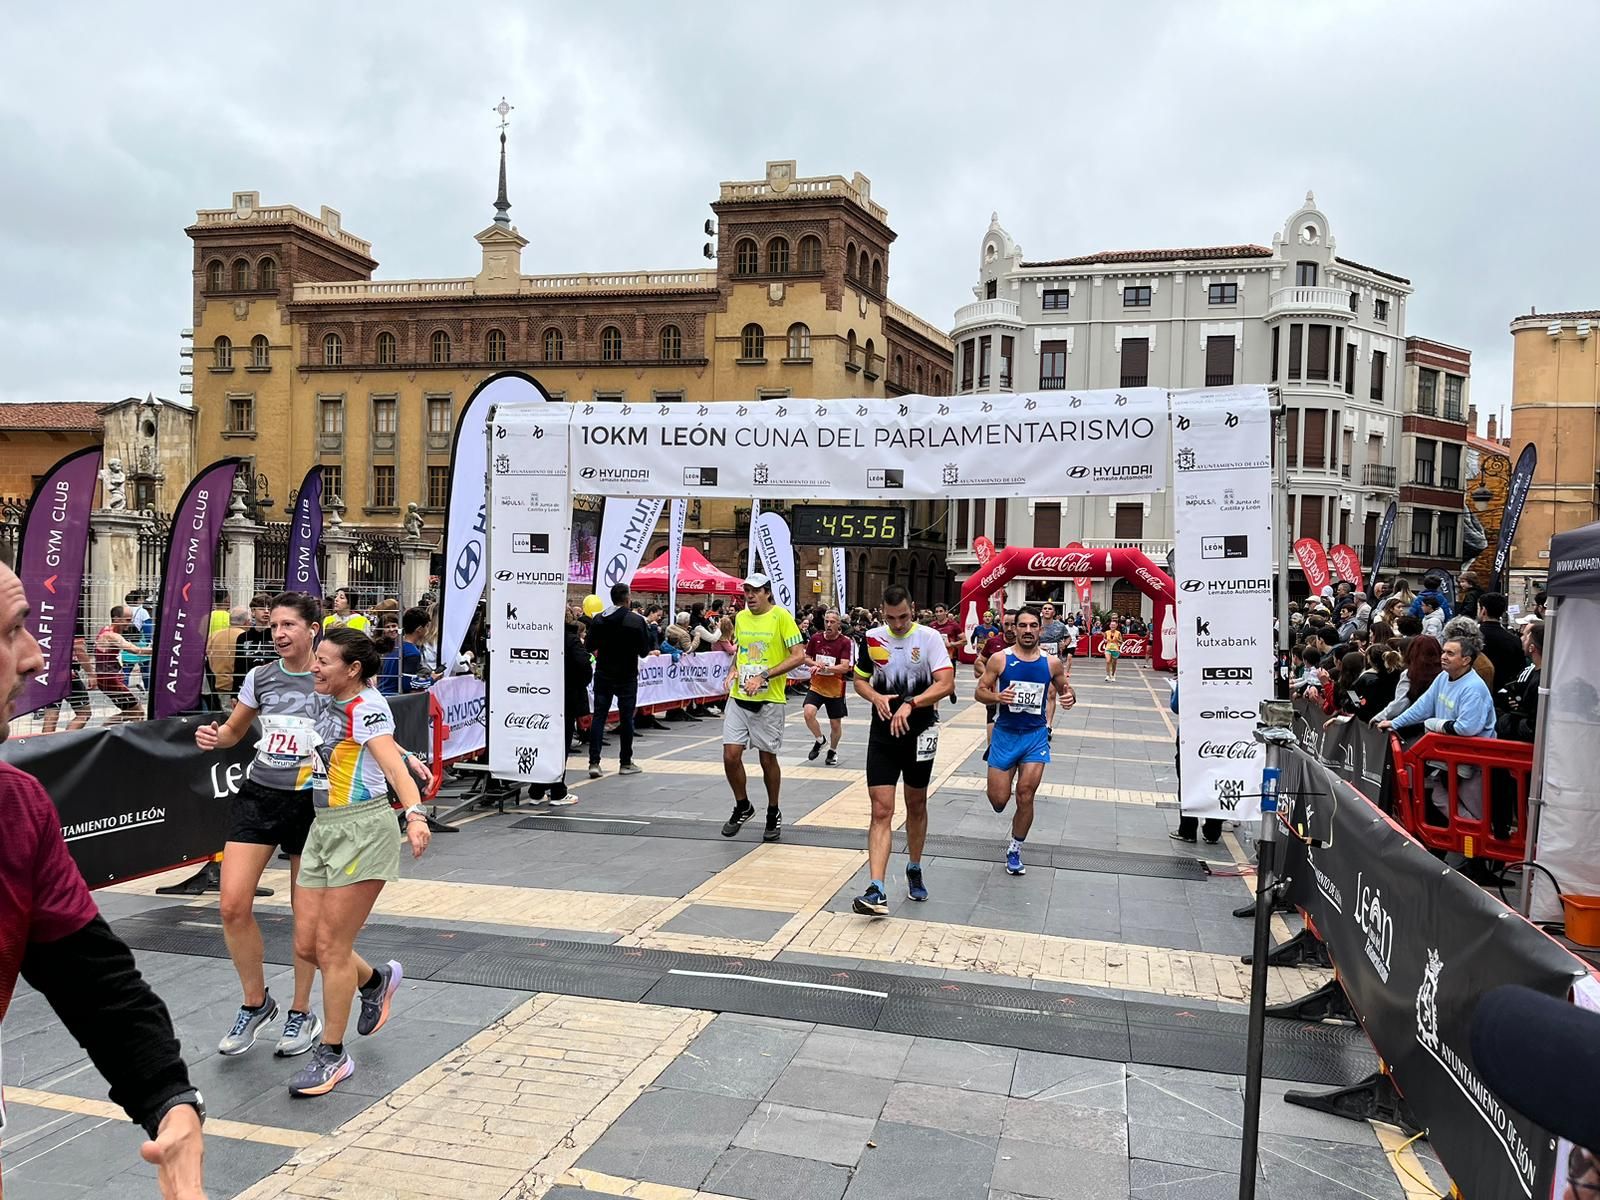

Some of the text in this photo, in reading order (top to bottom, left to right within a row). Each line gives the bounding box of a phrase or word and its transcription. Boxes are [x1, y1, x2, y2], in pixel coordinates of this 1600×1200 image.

[582, 417, 1154, 448] 10KM LEÓN CUNA DEL PARLAMENTARISMO
[600, 468, 650, 478] HYUNDAI
[1094, 465, 1153, 476] HYUNDAI
[52, 480, 70, 522] CLUB
[46, 528, 64, 567] GYM
[1204, 542, 1223, 551] LEÓN
[298, 542, 312, 583] GYM
[1028, 552, 1094, 572] Coca-Cola
[517, 572, 564, 581] HYUNDAI
[677, 580, 705, 590] Coca-Cola
[980, 564, 1007, 588] Coca-Cola
[1136, 568, 1167, 591] Coca-Cola
[1208, 580, 1270, 590] HYUNDAI
[166, 490, 208, 694] ALTAFIT GYM CLUB
[506, 622, 554, 631] kutxabank
[1196, 637, 1257, 648] kutxabank
[508, 682, 550, 694] emico
[1018, 692, 1036, 704] 582
[504, 712, 552, 730] Coca-Cola
[1200, 706, 1256, 720] emico
[1198, 740, 1258, 760] Coca-Cola
[60, 806, 166, 837] TAMIENTO DE LEÓN
[1442, 1042, 1536, 1186] AYUNTAMIENTO DE LEÓN
